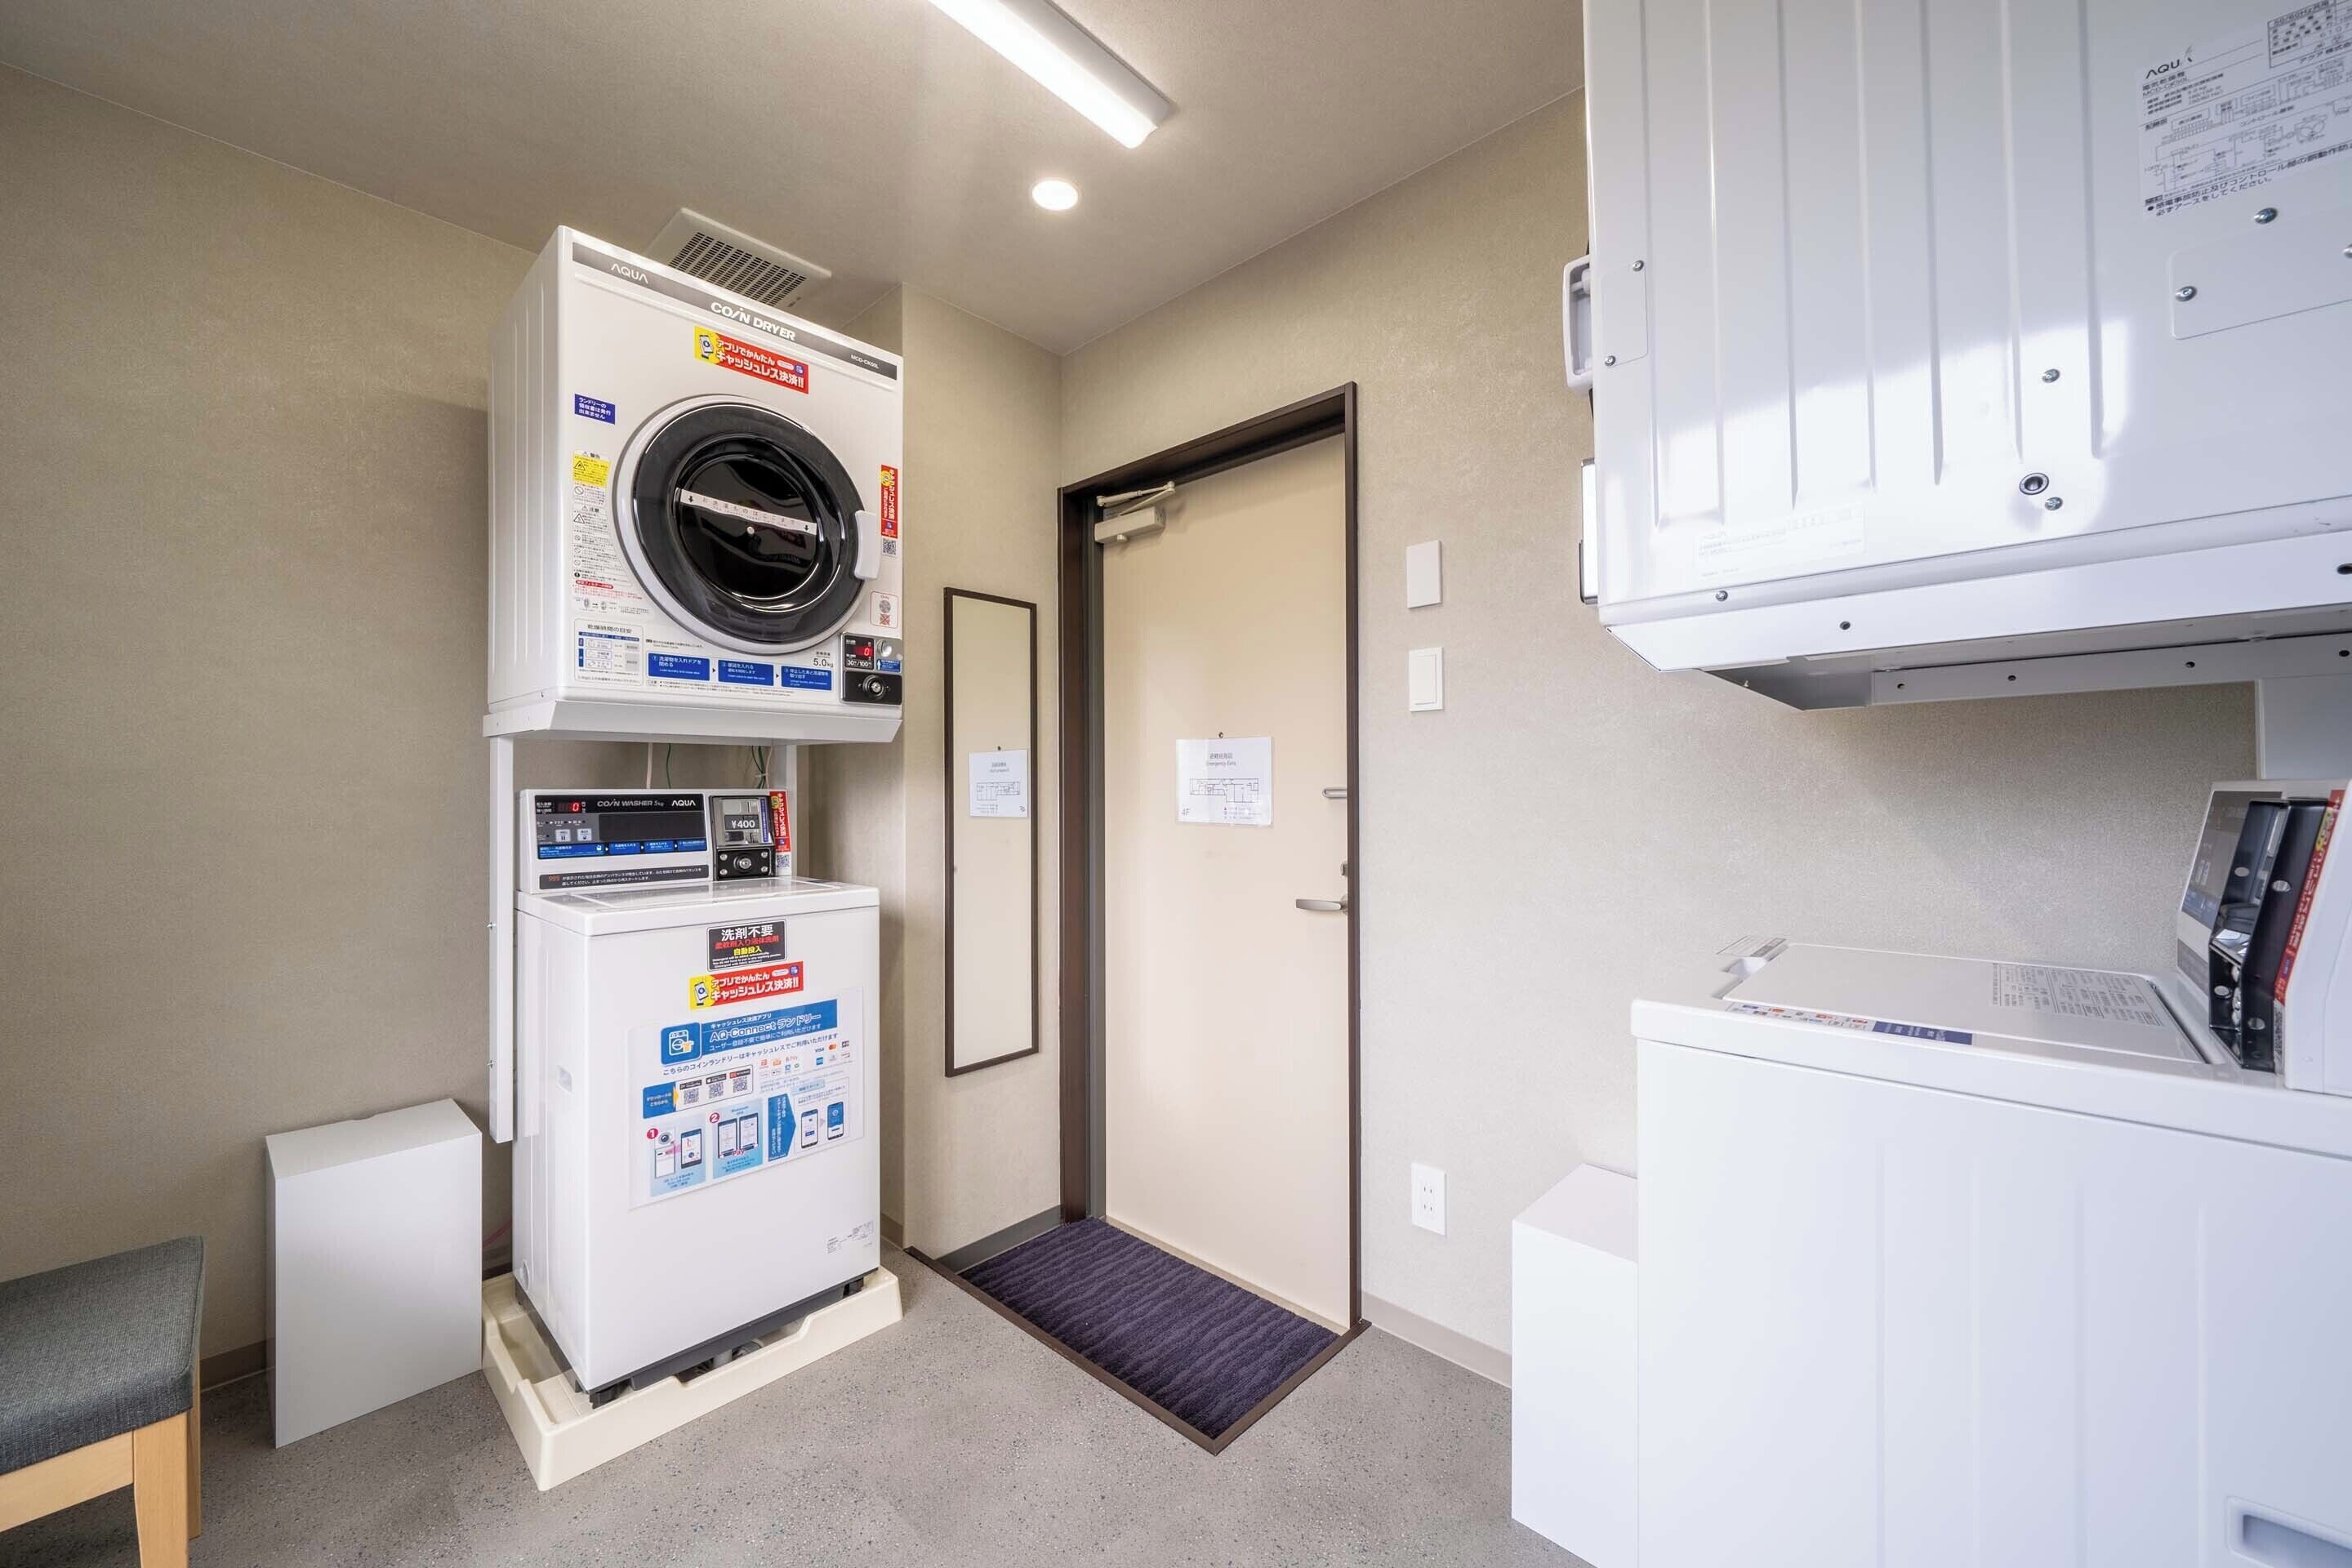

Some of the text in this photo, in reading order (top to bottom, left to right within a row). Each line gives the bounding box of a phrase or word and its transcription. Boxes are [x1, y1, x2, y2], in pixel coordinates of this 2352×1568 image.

[611, 263, 648, 284] AQUA
[710, 302, 796, 341] COIN DRYER
[717, 340, 775, 366] アプリでかんたん
[597, 799, 620, 807] COIN
[731, 820, 755, 829] ¥400
[721, 924, 773, 942] 洗剤不要
[733, 946, 762, 956] 自動投入
[711, 971, 770, 988] アプリでかんたん
[709, 1013, 822, 1043] AQ-Connect ランドリー
